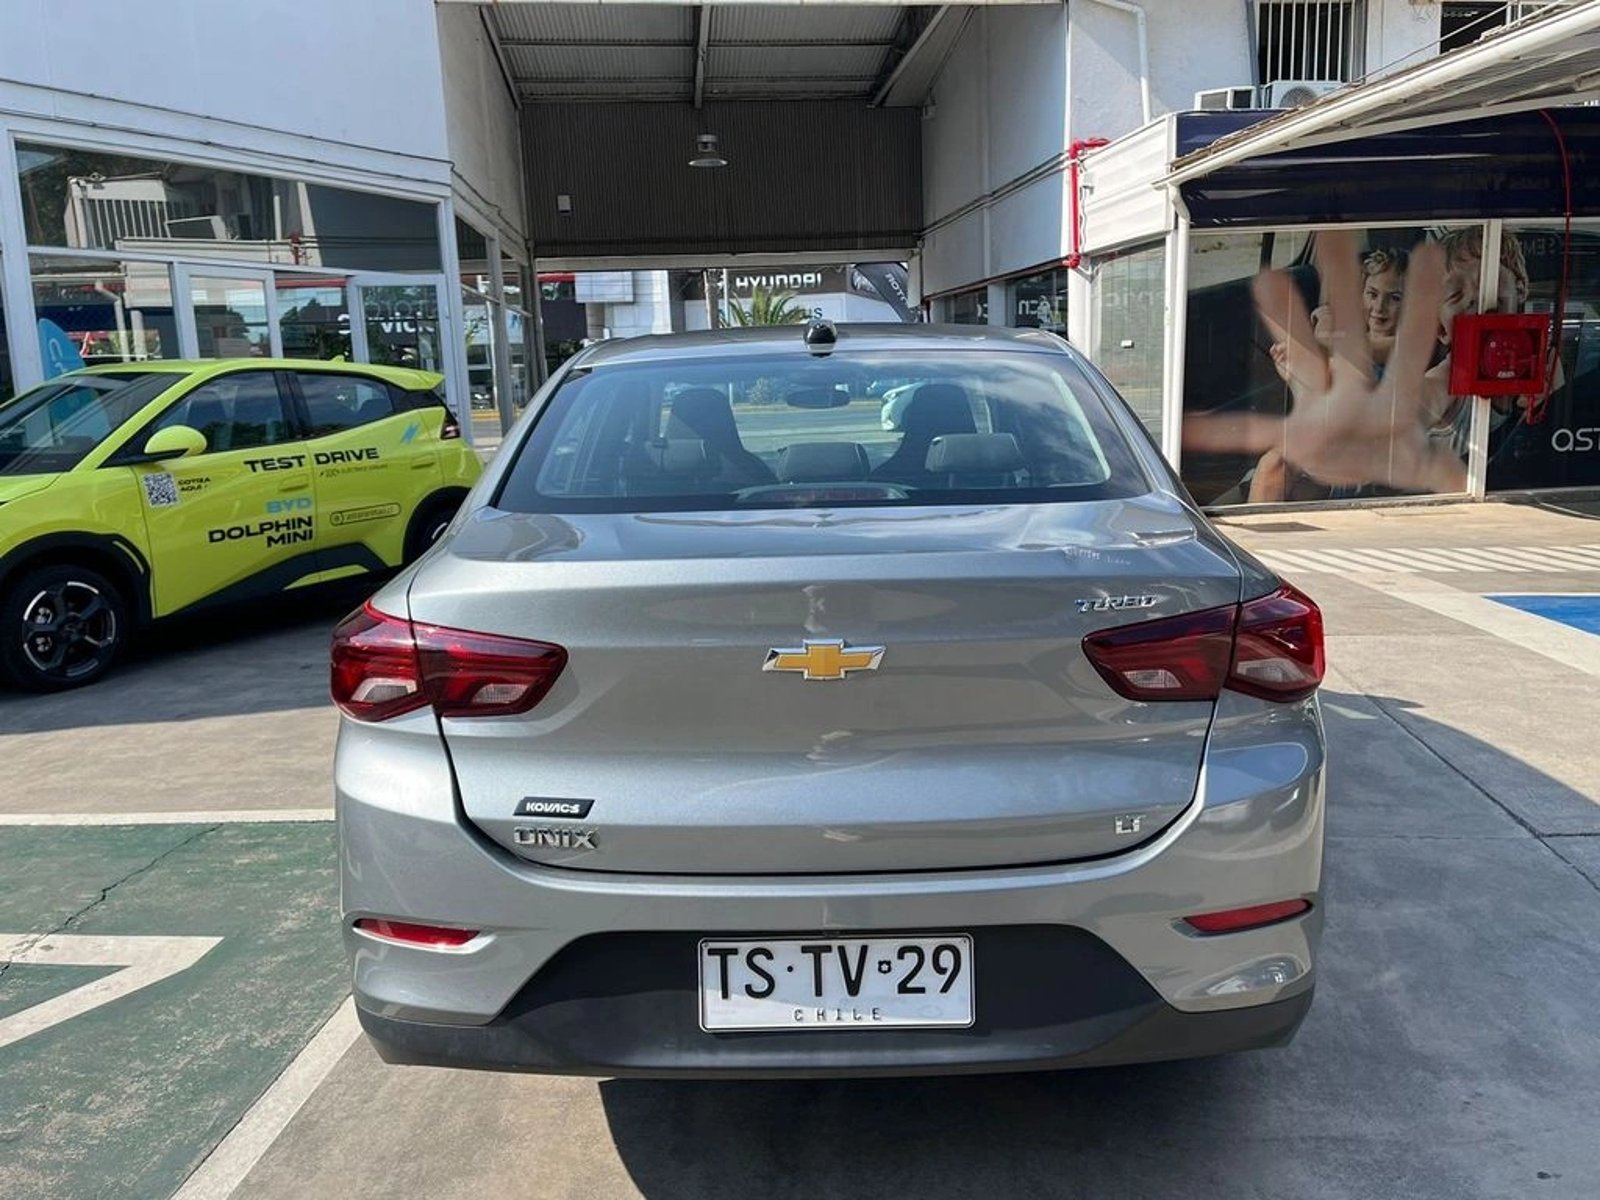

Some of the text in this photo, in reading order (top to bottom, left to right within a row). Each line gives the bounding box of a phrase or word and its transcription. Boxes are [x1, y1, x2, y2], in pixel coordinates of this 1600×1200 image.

[735, 272, 822, 289] HYUNDAI
[244, 447, 380, 473] TEST DRIVE
[265, 496, 313, 515] BYD
[208, 516, 314, 543] DOLPHIN
[265, 530, 314, 549] MINI
[1074, 593, 1161, 613] TURBO
[525, 801, 581, 814] KOVACS
[513, 825, 600, 850] ONIX
[793, 1006, 883, 1023] CHILE
